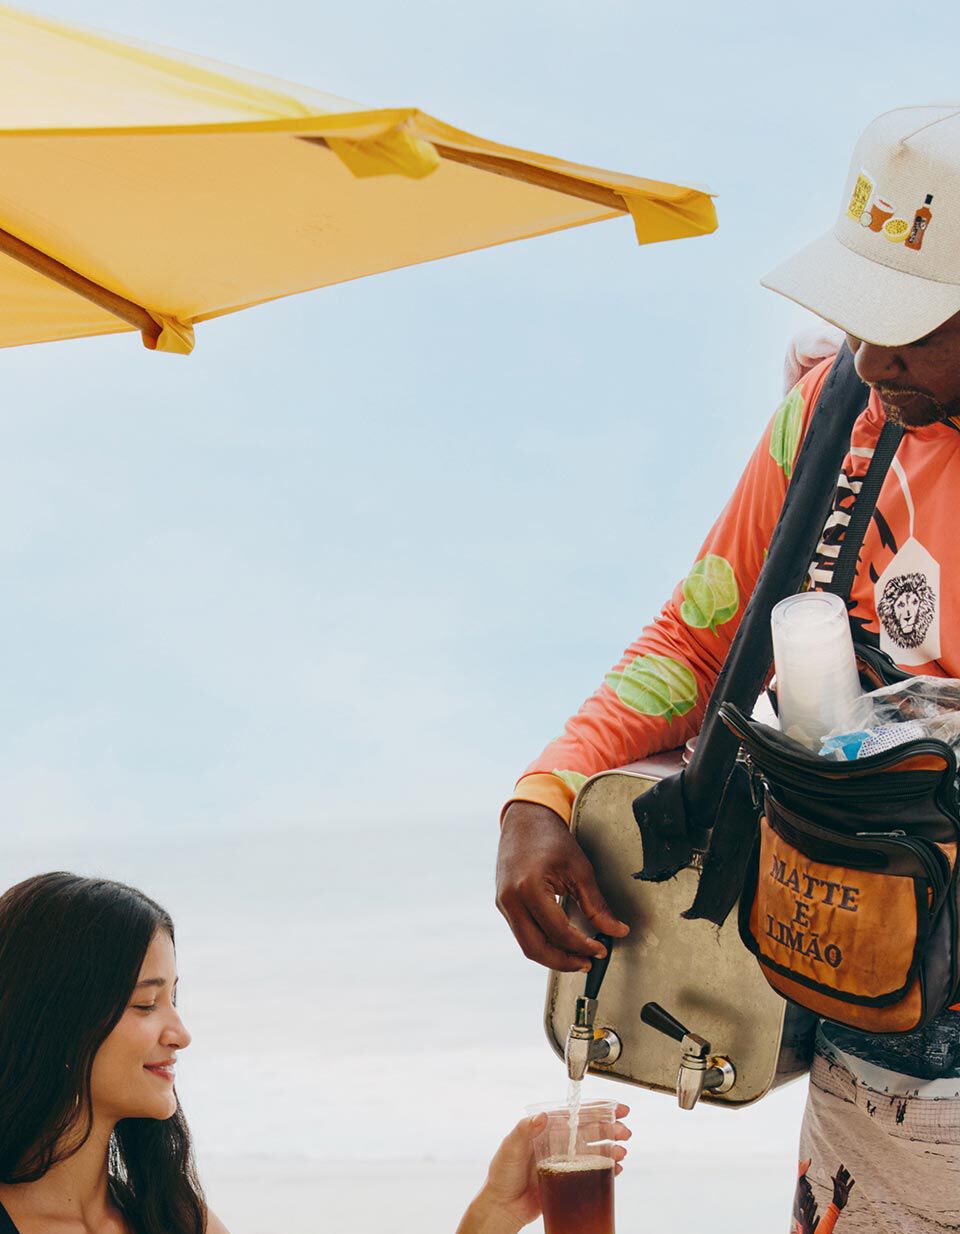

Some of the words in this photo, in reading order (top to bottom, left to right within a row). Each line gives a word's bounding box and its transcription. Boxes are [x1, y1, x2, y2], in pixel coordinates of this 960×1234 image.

[769, 853, 860, 913] MATTE
[766, 913, 843, 968] LIMÃO
[792, 900, 810, 928] E
